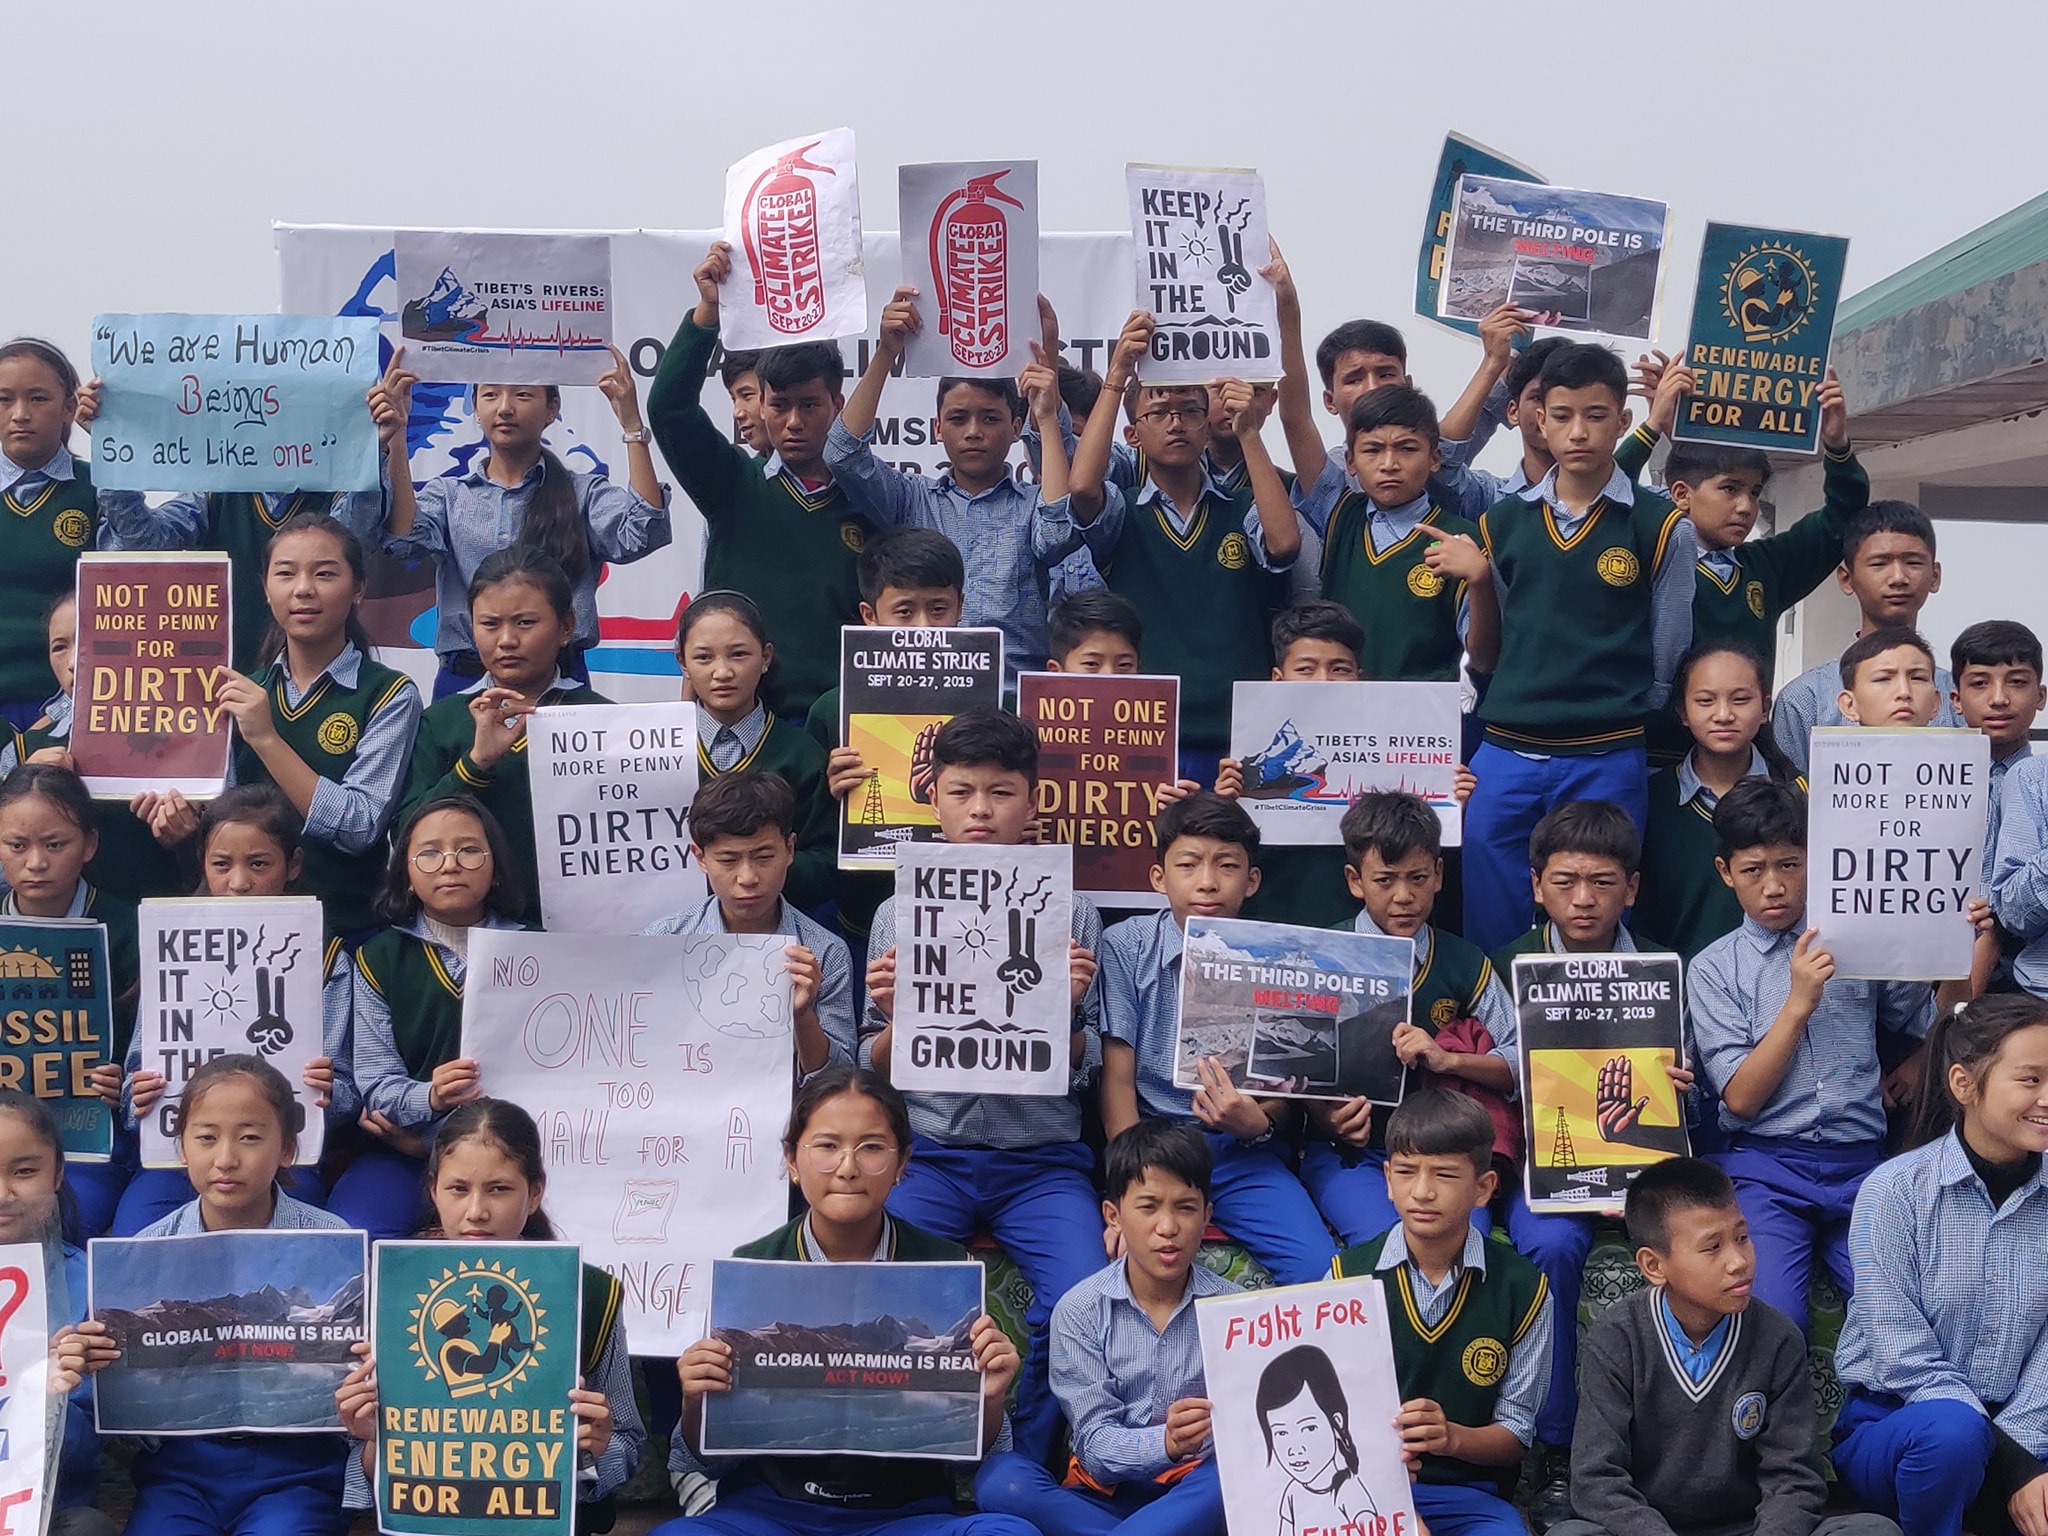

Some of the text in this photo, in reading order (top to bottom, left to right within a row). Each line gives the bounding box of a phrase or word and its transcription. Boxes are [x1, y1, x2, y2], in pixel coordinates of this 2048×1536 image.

[760, 190, 811, 209] GLOBAL
[1142, 188, 1211, 229] KEEP
[949, 223, 1002, 239] GLOBAL
[1146, 220, 1170, 247] IT
[1471, 214, 1508, 233] THE
[1511, 219, 1567, 240] THIRD
[1571, 227, 1620, 247] POLE
[1624, 233, 1643, 249] IS
[761, 209, 793, 314] CLIMATE
[788, 203, 820, 311] STRIKE
[1514, 239, 1595, 262] MELTING
[1150, 252, 1178, 280] IN
[474, 282, 605, 297] TIBET'S RIVERS:
[950, 239, 976, 347] CLIMATE
[978, 238, 1004, 347] STRIKE
[1150, 285, 1206, 313] THE
[491, 299, 605, 312] ASIA'S LIFELINE
[772, 312, 801, 329] SEPT
[169, 333, 220, 363] are
[235, 324, 355, 373] Human
[954, 343, 983, 364] SEPT
[1152, 331, 1270, 361] GROUND
[1692, 344, 1821, 376] RENEWABLE
[1692, 368, 1817, 407] ENERGY
[177, 375, 280, 430] Beings
[1689, 402, 1807, 434] FOR ALL
[102, 437, 134, 463] So
[153, 437, 191, 465] act
[96, 584, 219, 608] NOT ONE
[95, 614, 219, 631] MORE PENNY
[136, 640, 175, 658] FOR
[892, 630, 952, 648] GLOBAL
[853, 651, 990, 670] CLIMATE STRIKE
[92, 666, 220, 702] DIRTY
[868, 674, 974, 690] SEPT 20-27, 2019
[89, 705, 221, 734] ENERGY
[1039, 698, 1167, 724] NOT ONE
[551, 727, 684, 754] NOT ONE
[1038, 727, 1166, 746] MORE PENNY
[1315, 735, 1453, 748] TIBET'S RIVERS:
[552, 755, 683, 777] MORE PENNY
[1081, 754, 1120, 772] FOR
[1331, 752, 1453, 764] ASIA'S LIFELINE
[1834, 763, 1974, 785] NOT ONE
[599, 783, 639, 801] FOR
[1038, 779, 1166, 816] DIRTY
[1832, 794, 1972, 809] MORE PENNY
[557, 805, 690, 846] DIRTY
[1880, 820, 1921, 837] FOR
[560, 844, 691, 877] ENERGY
[1832, 848, 1972, 882] DIRTY
[915, 867, 1002, 915] KEEP
[1831, 887, 1970, 914] ENERGY
[914, 905, 944, 938] IT
[158, 928, 249, 975] KEEP
[914, 944, 947, 976] IN
[491, 955, 539, 987] NO
[1201, 962, 1389, 996] THE THIRD POLE IS
[1565, 960, 1629, 979] GLOBAL
[159, 969, 189, 1002] IT
[912, 981, 976, 1015] THE
[1528, 981, 1671, 1002] CLIMATE STRIKE
[1253, 989, 1340, 1014] MELTING
[1545, 1007, 1655, 1023] SEPT 20-27, 2019
[0, 1010, 99, 1045] SSIL
[159, 1008, 193, 1042] IN
[523, 992, 714, 1074] ONE IS
[911, 1034, 1052, 1072] GROUND
[0, 1051, 101, 1098] REE
[598, 1081, 656, 1109] TOO
[637, 1136, 689, 1167] FOR
[725, 1106, 753, 1174] A
[1315, 1299, 1368, 1330] FOR
[142, 1325, 364, 1346] GLOBAL WARMING IS REAL
[214, 1344, 246, 1358] ACT
[754, 1352, 824, 1368] GLOBAL
[827, 1353, 913, 1370] WARMING
[917, 1355, 935, 1370] IS
[824, 1370, 910, 1386] ACT NOW!
[385, 1407, 565, 1434] RENEWABLE
[386, 1438, 564, 1479] ENERGY
[392, 1482, 556, 1515] FOR ALL
